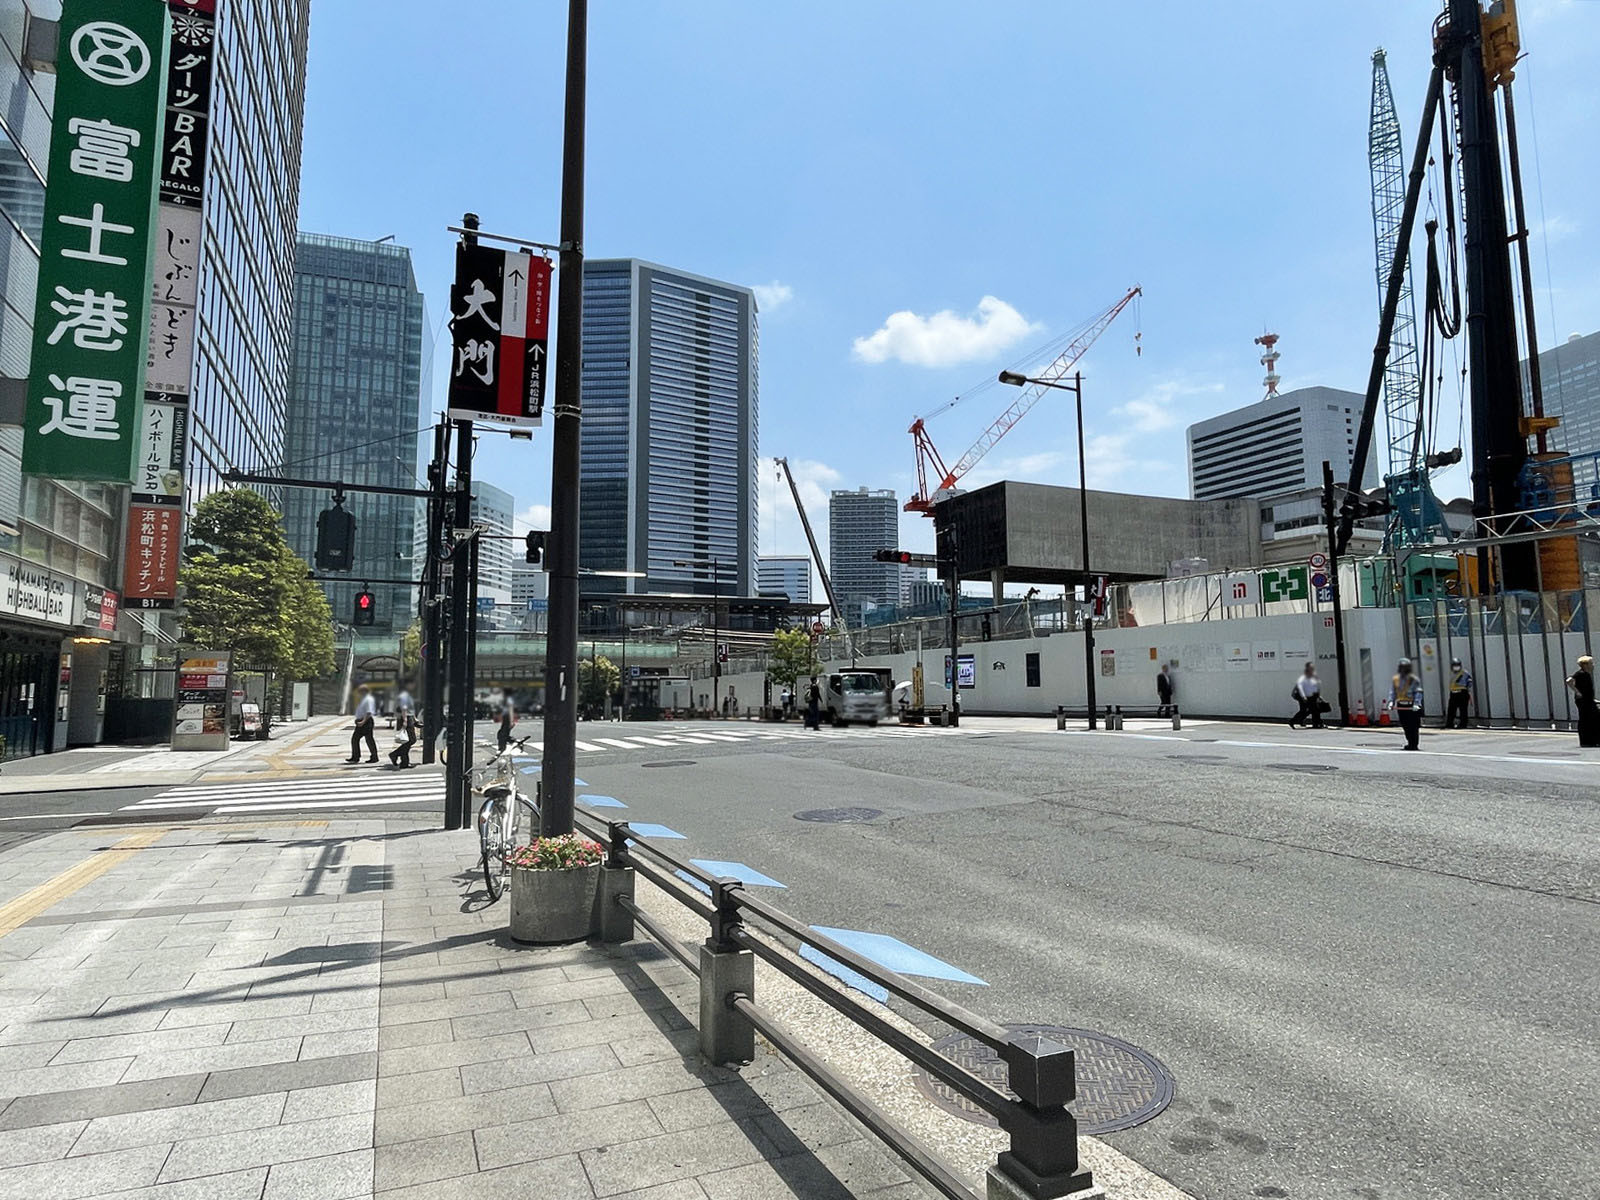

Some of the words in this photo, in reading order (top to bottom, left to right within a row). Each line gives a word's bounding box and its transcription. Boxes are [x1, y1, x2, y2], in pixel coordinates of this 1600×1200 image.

[160, 180, 200, 192] REGALO
[39, 118, 141, 441] 富士港運
[163, 228, 192, 359] じぶんどき
[455, 278, 501, 386] 大門
[528, 364, 540, 413] JR浜松町駅
[145, 409, 164, 491] ハイボールBAR
[139, 510, 156, 592] 浜松町キッチン
[7, 587, 46, 613] HIGHBALL
[48, 599, 63, 616] BAR
